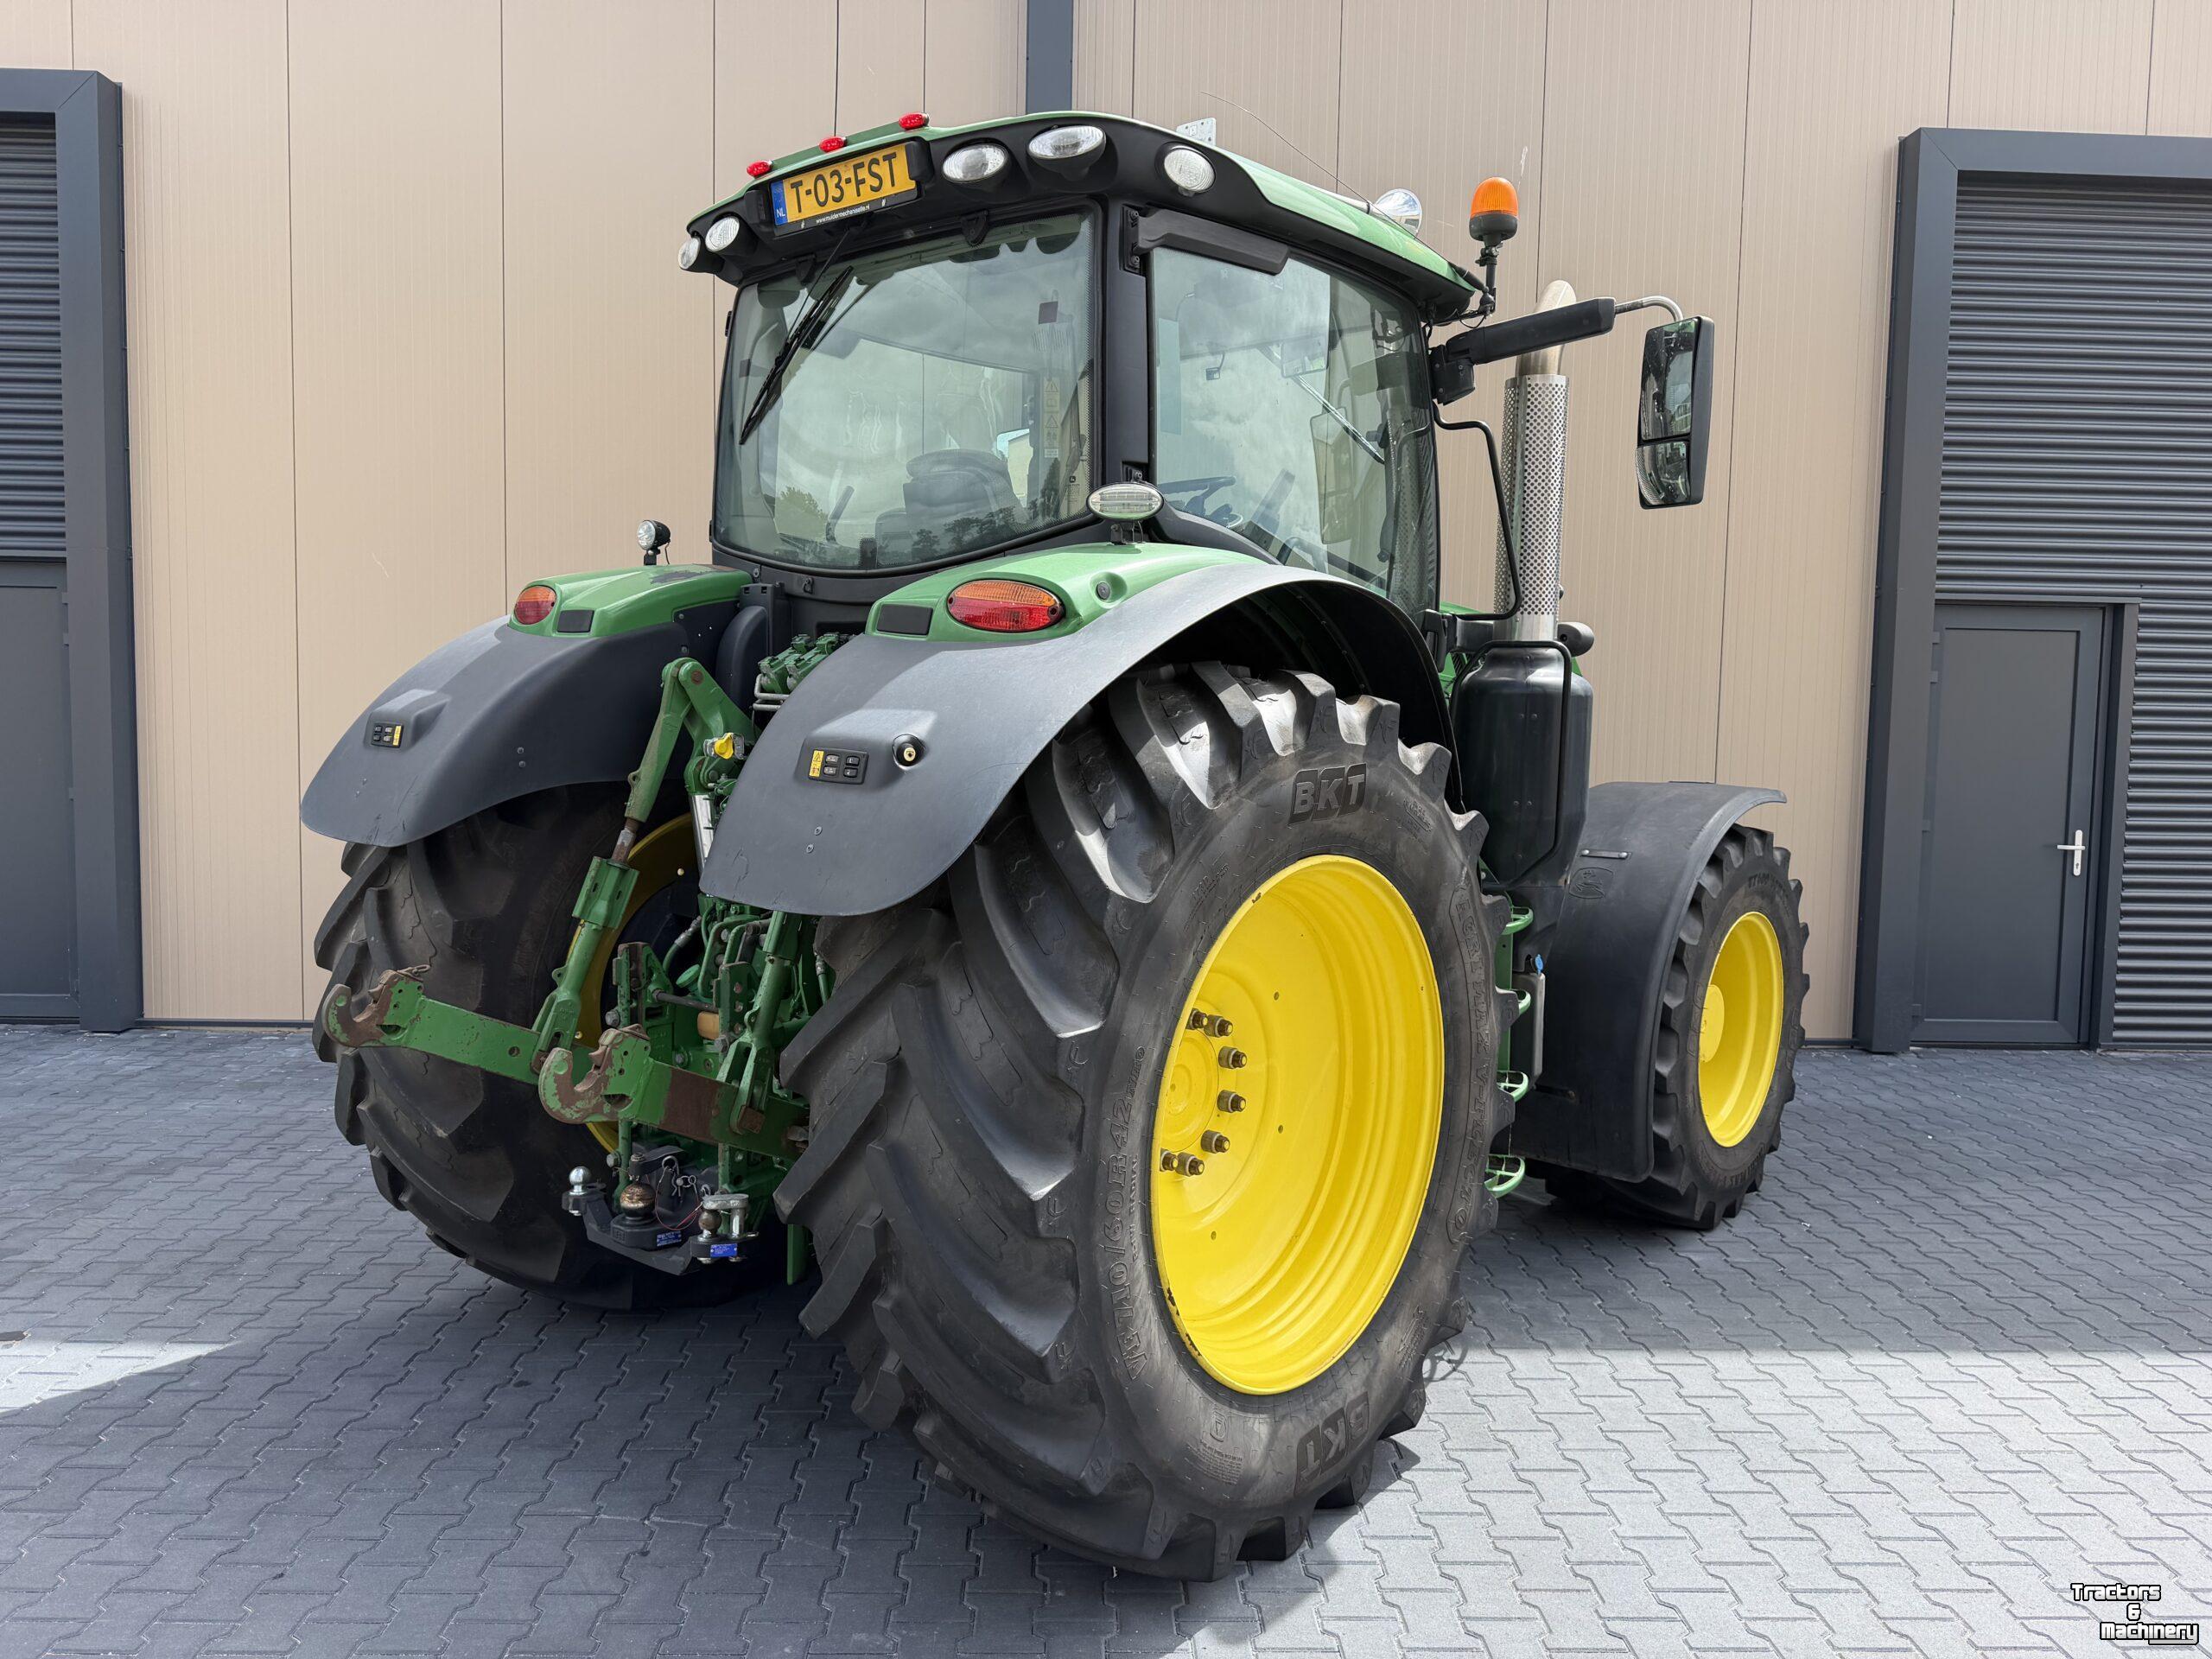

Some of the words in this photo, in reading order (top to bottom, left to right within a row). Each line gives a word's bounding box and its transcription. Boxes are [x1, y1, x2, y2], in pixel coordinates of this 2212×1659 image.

[790, 152, 897, 213] T-03-FST
[776, 207, 786, 218] NL
[815, 203, 870, 224] www.muldermechanisatie.nl
[1293, 772, 1366, 816] BKT
[1300, 1402, 1370, 1480] BKT
